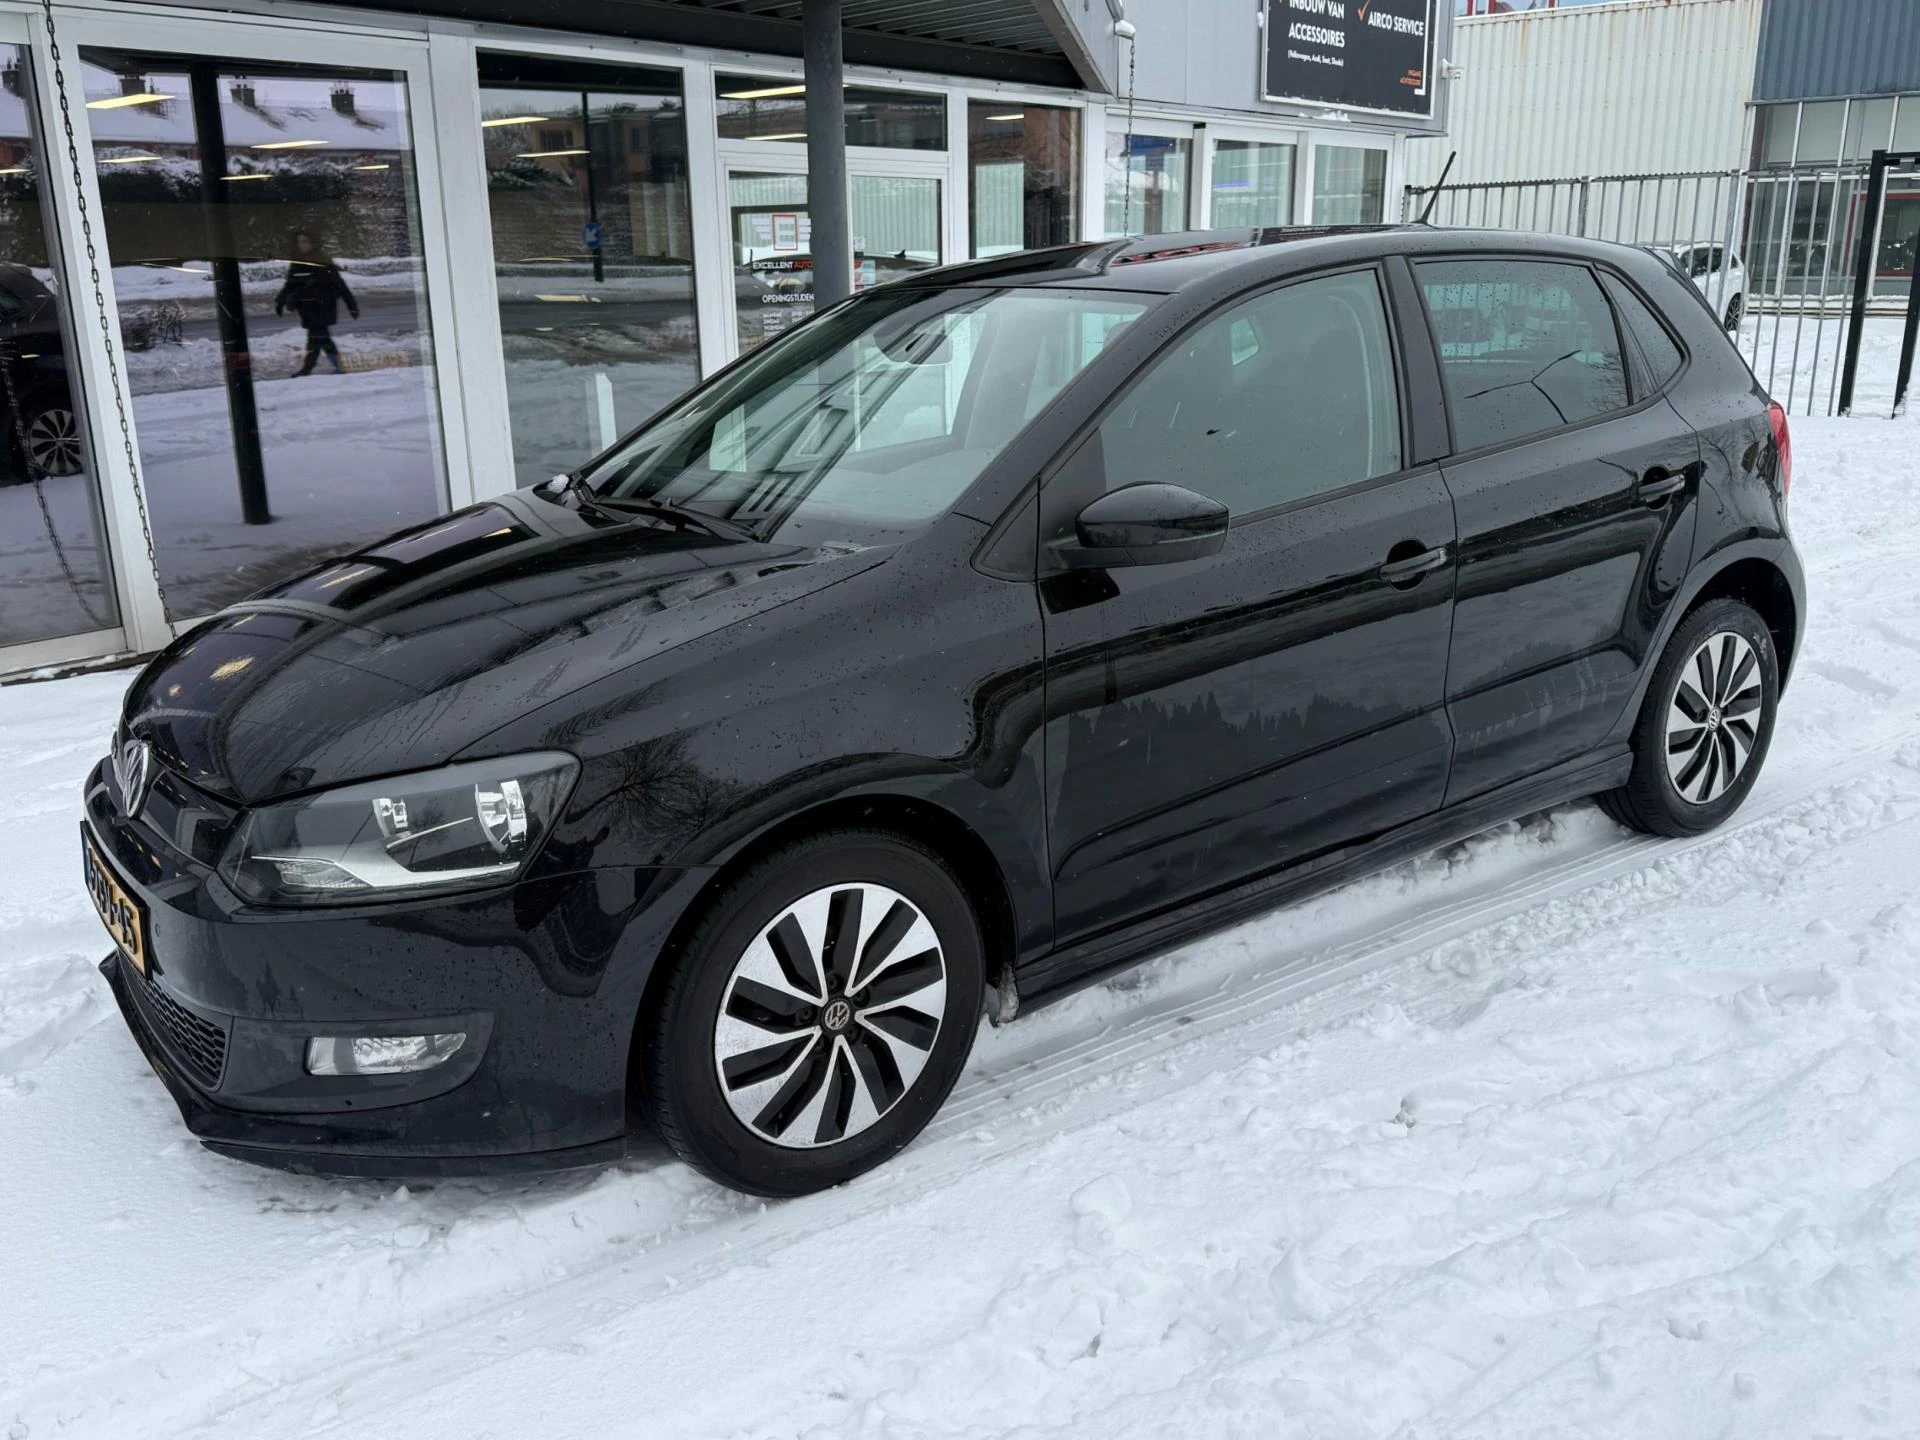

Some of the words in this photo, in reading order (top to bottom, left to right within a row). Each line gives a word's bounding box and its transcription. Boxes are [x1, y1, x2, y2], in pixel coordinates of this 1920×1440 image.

[1327, 1, 1345, 20] VAN
[1368, 11, 1392, 29] AIRCO
[1393, 16, 1424, 36] SERVICE
[1288, 23, 1345, 48] ACCESSOIRES
[753, 261, 793, 269] EXCELLENT
[762, 294, 814, 303] OPENINGSTIJDEN
